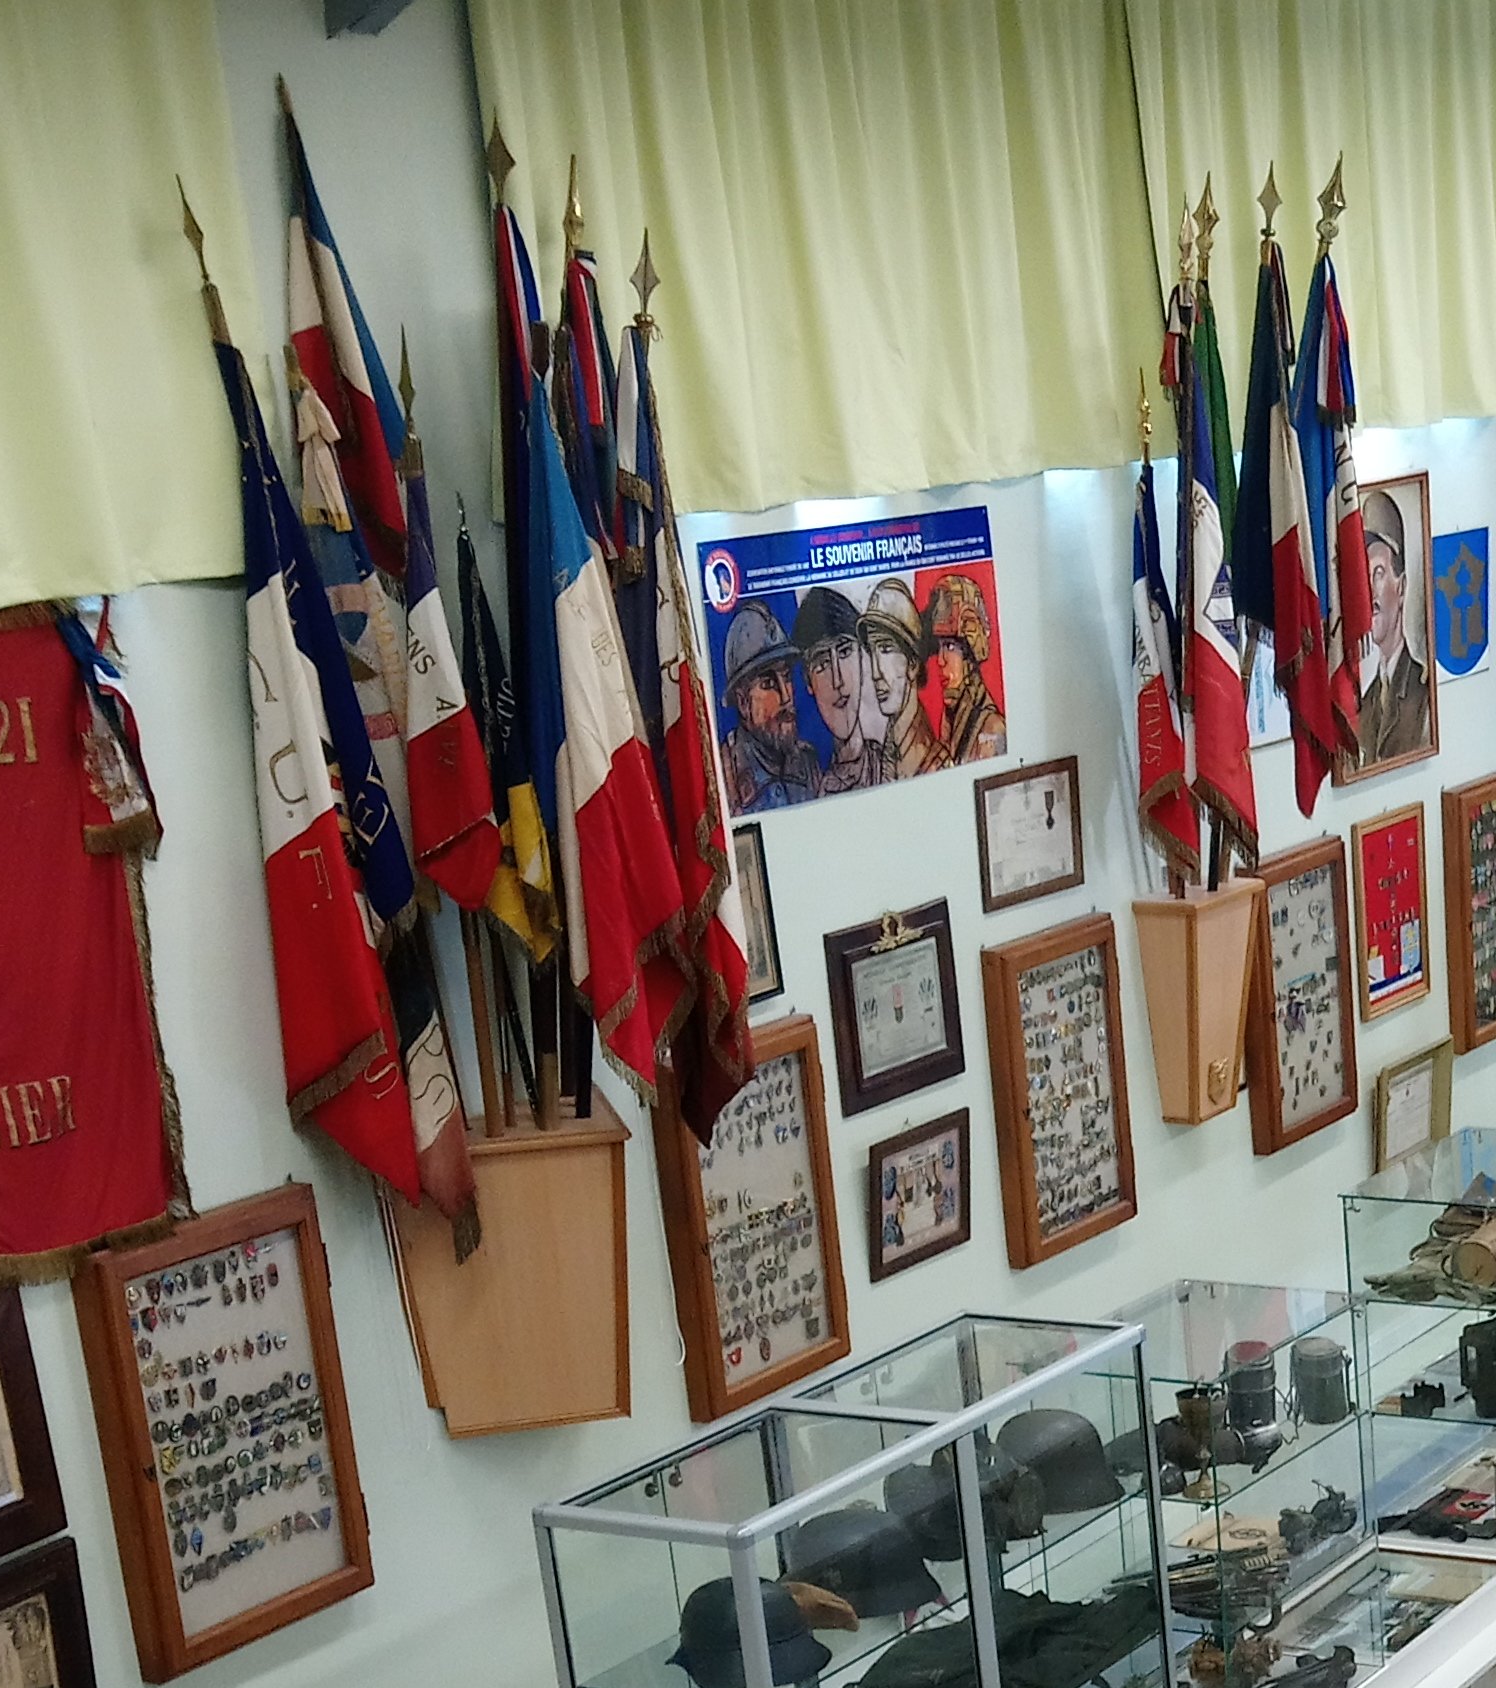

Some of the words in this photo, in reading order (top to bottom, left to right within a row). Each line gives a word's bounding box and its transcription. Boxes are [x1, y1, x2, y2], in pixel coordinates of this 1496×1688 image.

[810, 547, 824, 568] LE
[826, 539, 876, 566] SOUVENIR
[876, 534, 922, 563] FRANÇAIS
